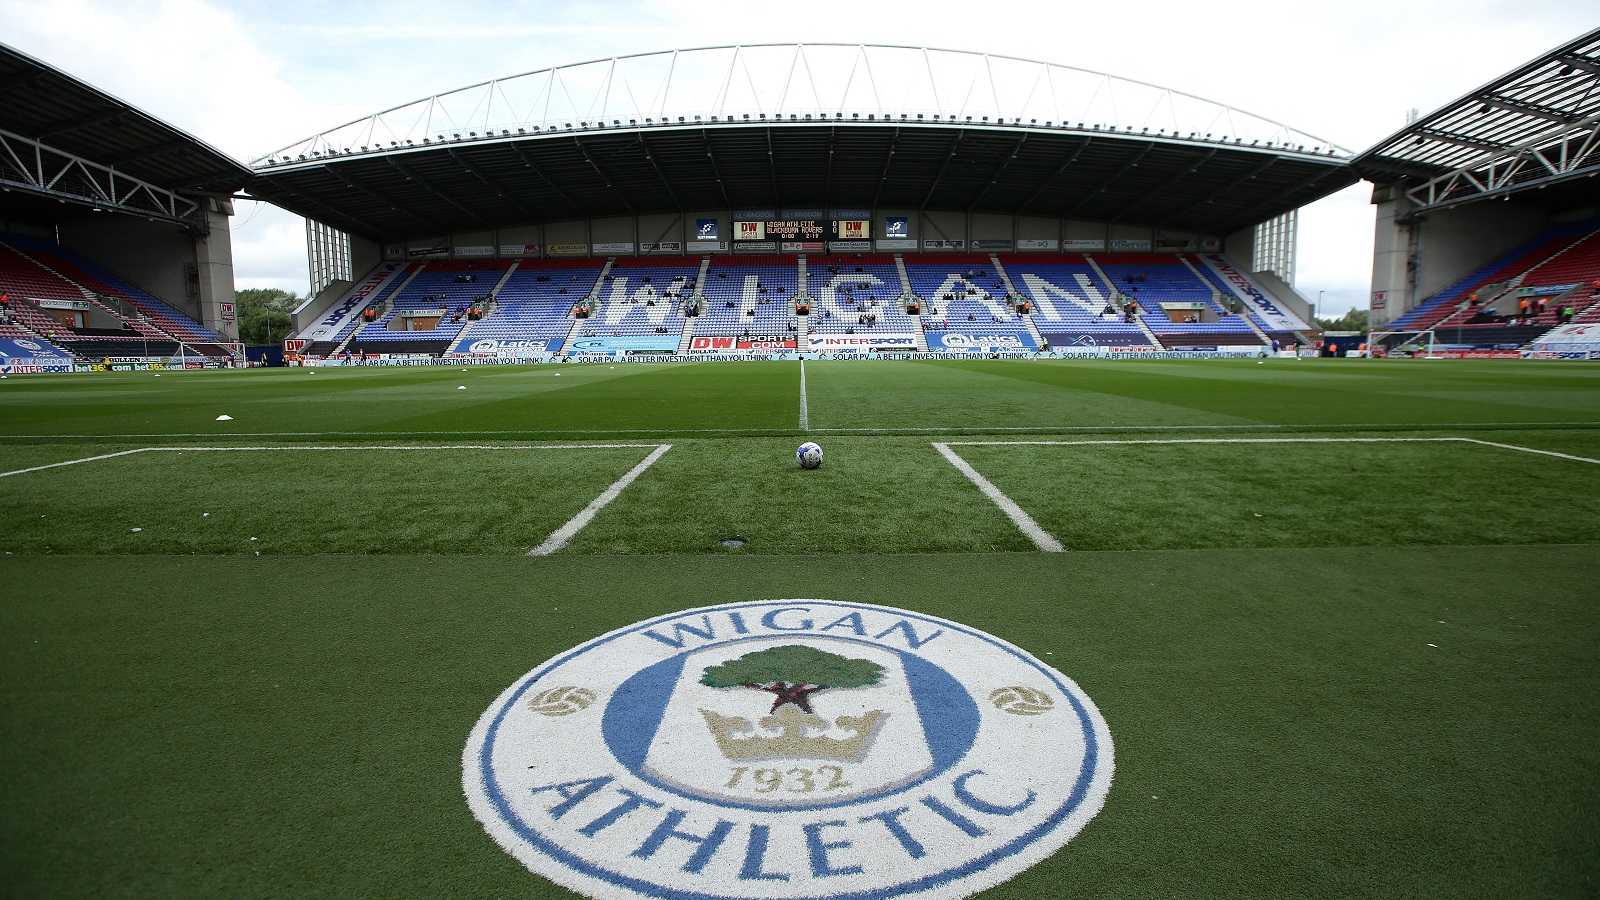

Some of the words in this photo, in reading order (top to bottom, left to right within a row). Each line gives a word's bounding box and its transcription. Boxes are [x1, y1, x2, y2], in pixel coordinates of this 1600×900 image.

[741, 223, 757, 232] DW
[846, 222, 863, 231] DW
[1214, 262, 1286, 317] INTERSPORT
[605, 274, 1120, 326] WIGAN
[287, 341, 305, 352] DW
[499, 340, 546, 348] Latics
[694, 338, 734, 349] DW
[431, 358, 477, 366] INVESTMENT
[13, 365, 70, 373] INTERSPORT
[642, 606, 948, 651] WIGAN
[723, 764, 855, 795] 1932
[530, 768, 1040, 883] ATHLETIC
